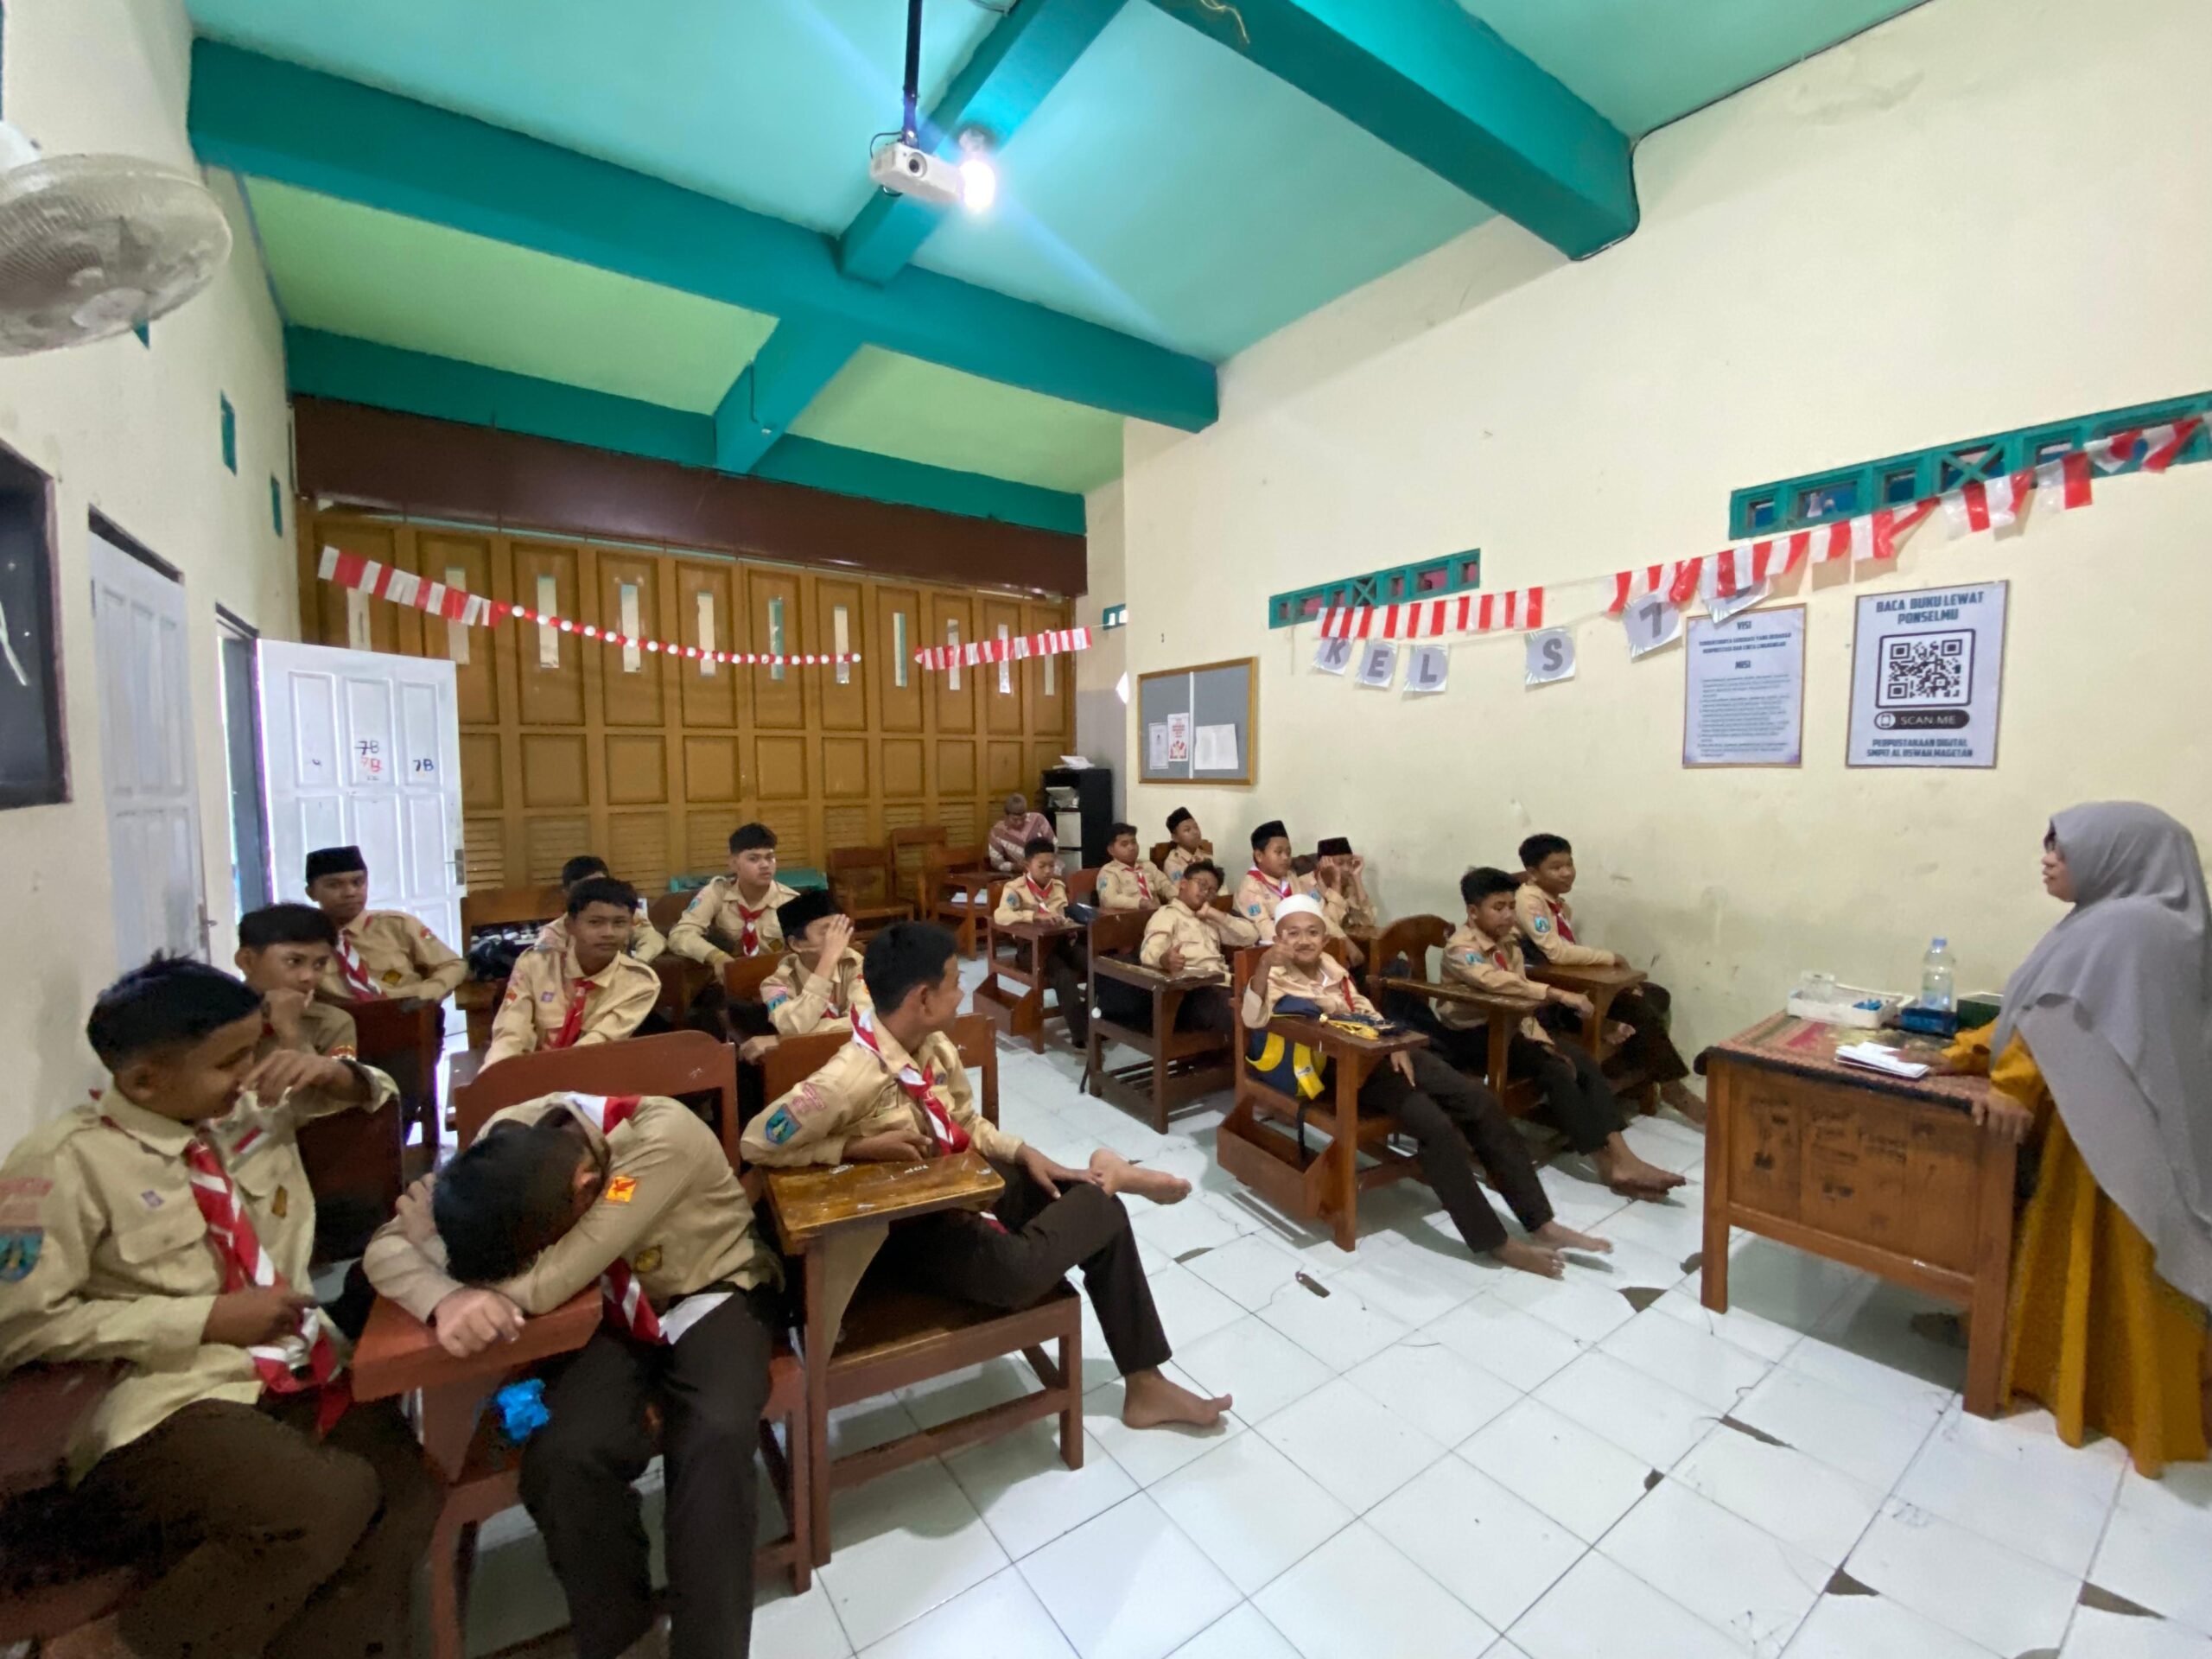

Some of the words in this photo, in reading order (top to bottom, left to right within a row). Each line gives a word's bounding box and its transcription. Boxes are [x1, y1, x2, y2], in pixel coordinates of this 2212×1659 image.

[1876, 599, 1906, 613] BACA
[1910, 595, 1942, 609] BUKU
[1943, 591, 1985, 607] LEWAT
[1897, 608, 1960, 625] PONSELMU
[1737, 620, 1752, 630] VISI
[1735, 660, 1751, 670] MISI
[1900, 716, 1933, 726] SCAN
[1936, 715, 1956, 725] ME
[354, 741, 380, 755] 7B
[1936, 738, 1967, 747] DIGITAL
[1891, 748, 1901, 757] AL
[413, 759, 434, 772] 7B
